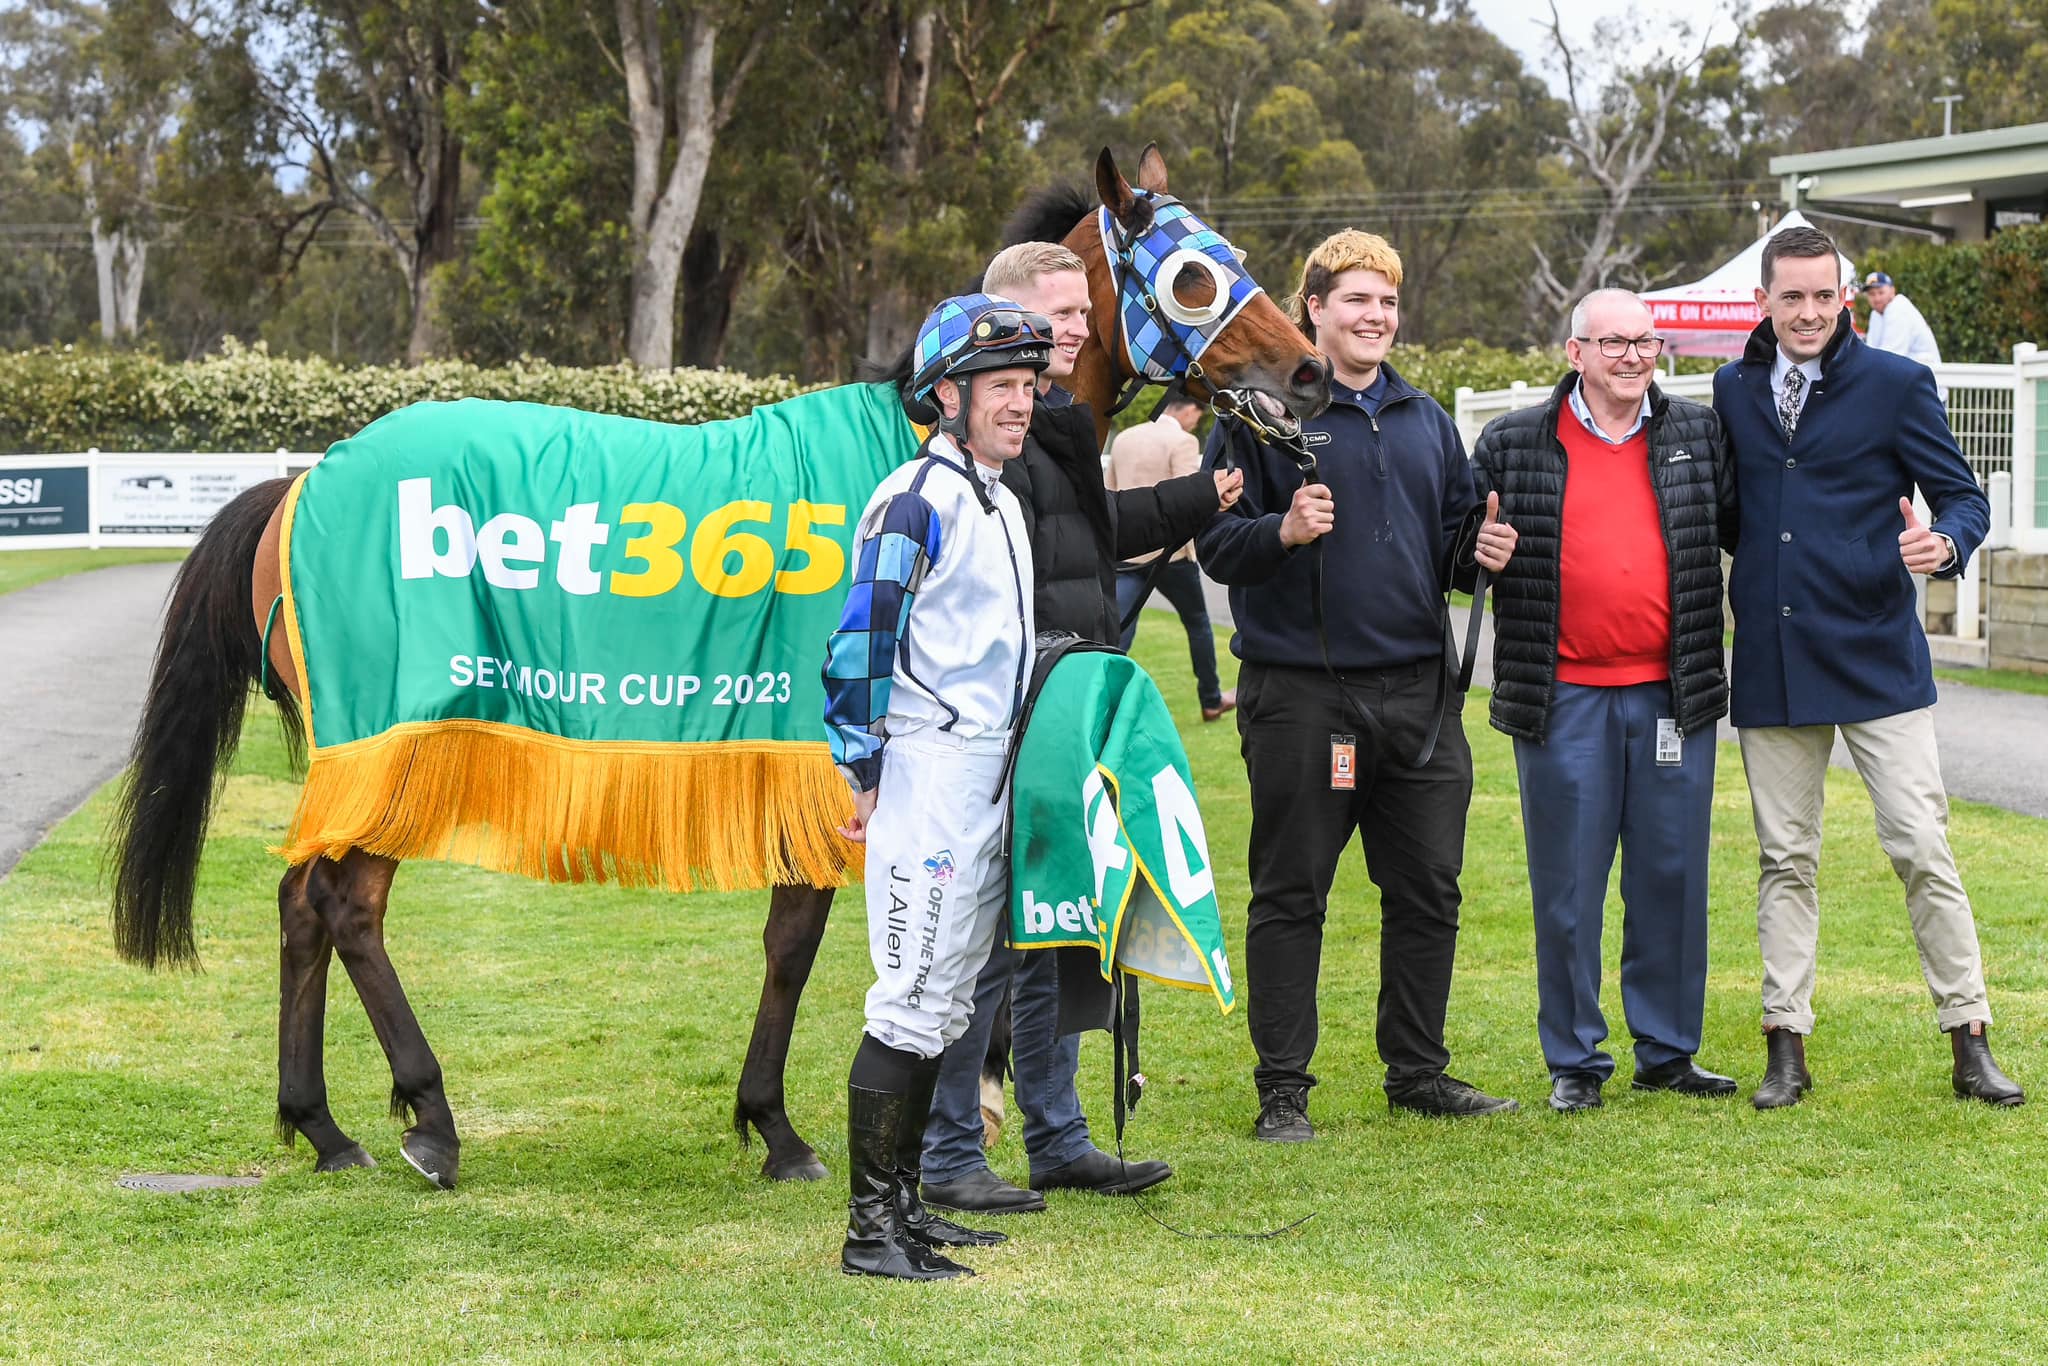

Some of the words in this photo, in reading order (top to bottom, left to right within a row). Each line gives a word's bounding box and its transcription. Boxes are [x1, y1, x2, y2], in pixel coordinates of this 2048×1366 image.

[1680, 303, 1700, 321] ON
[1021, 350, 1039, 358] LAS
[397, 476, 847, 598] bet365
[449, 654, 607, 704] SEYMOUR
[618, 673, 701, 706] CUP
[713, 671, 791, 706] 2023
[926, 886, 944, 924] OFF
[1022, 890, 1098, 936] bet
[920, 926, 938, 962] THE
